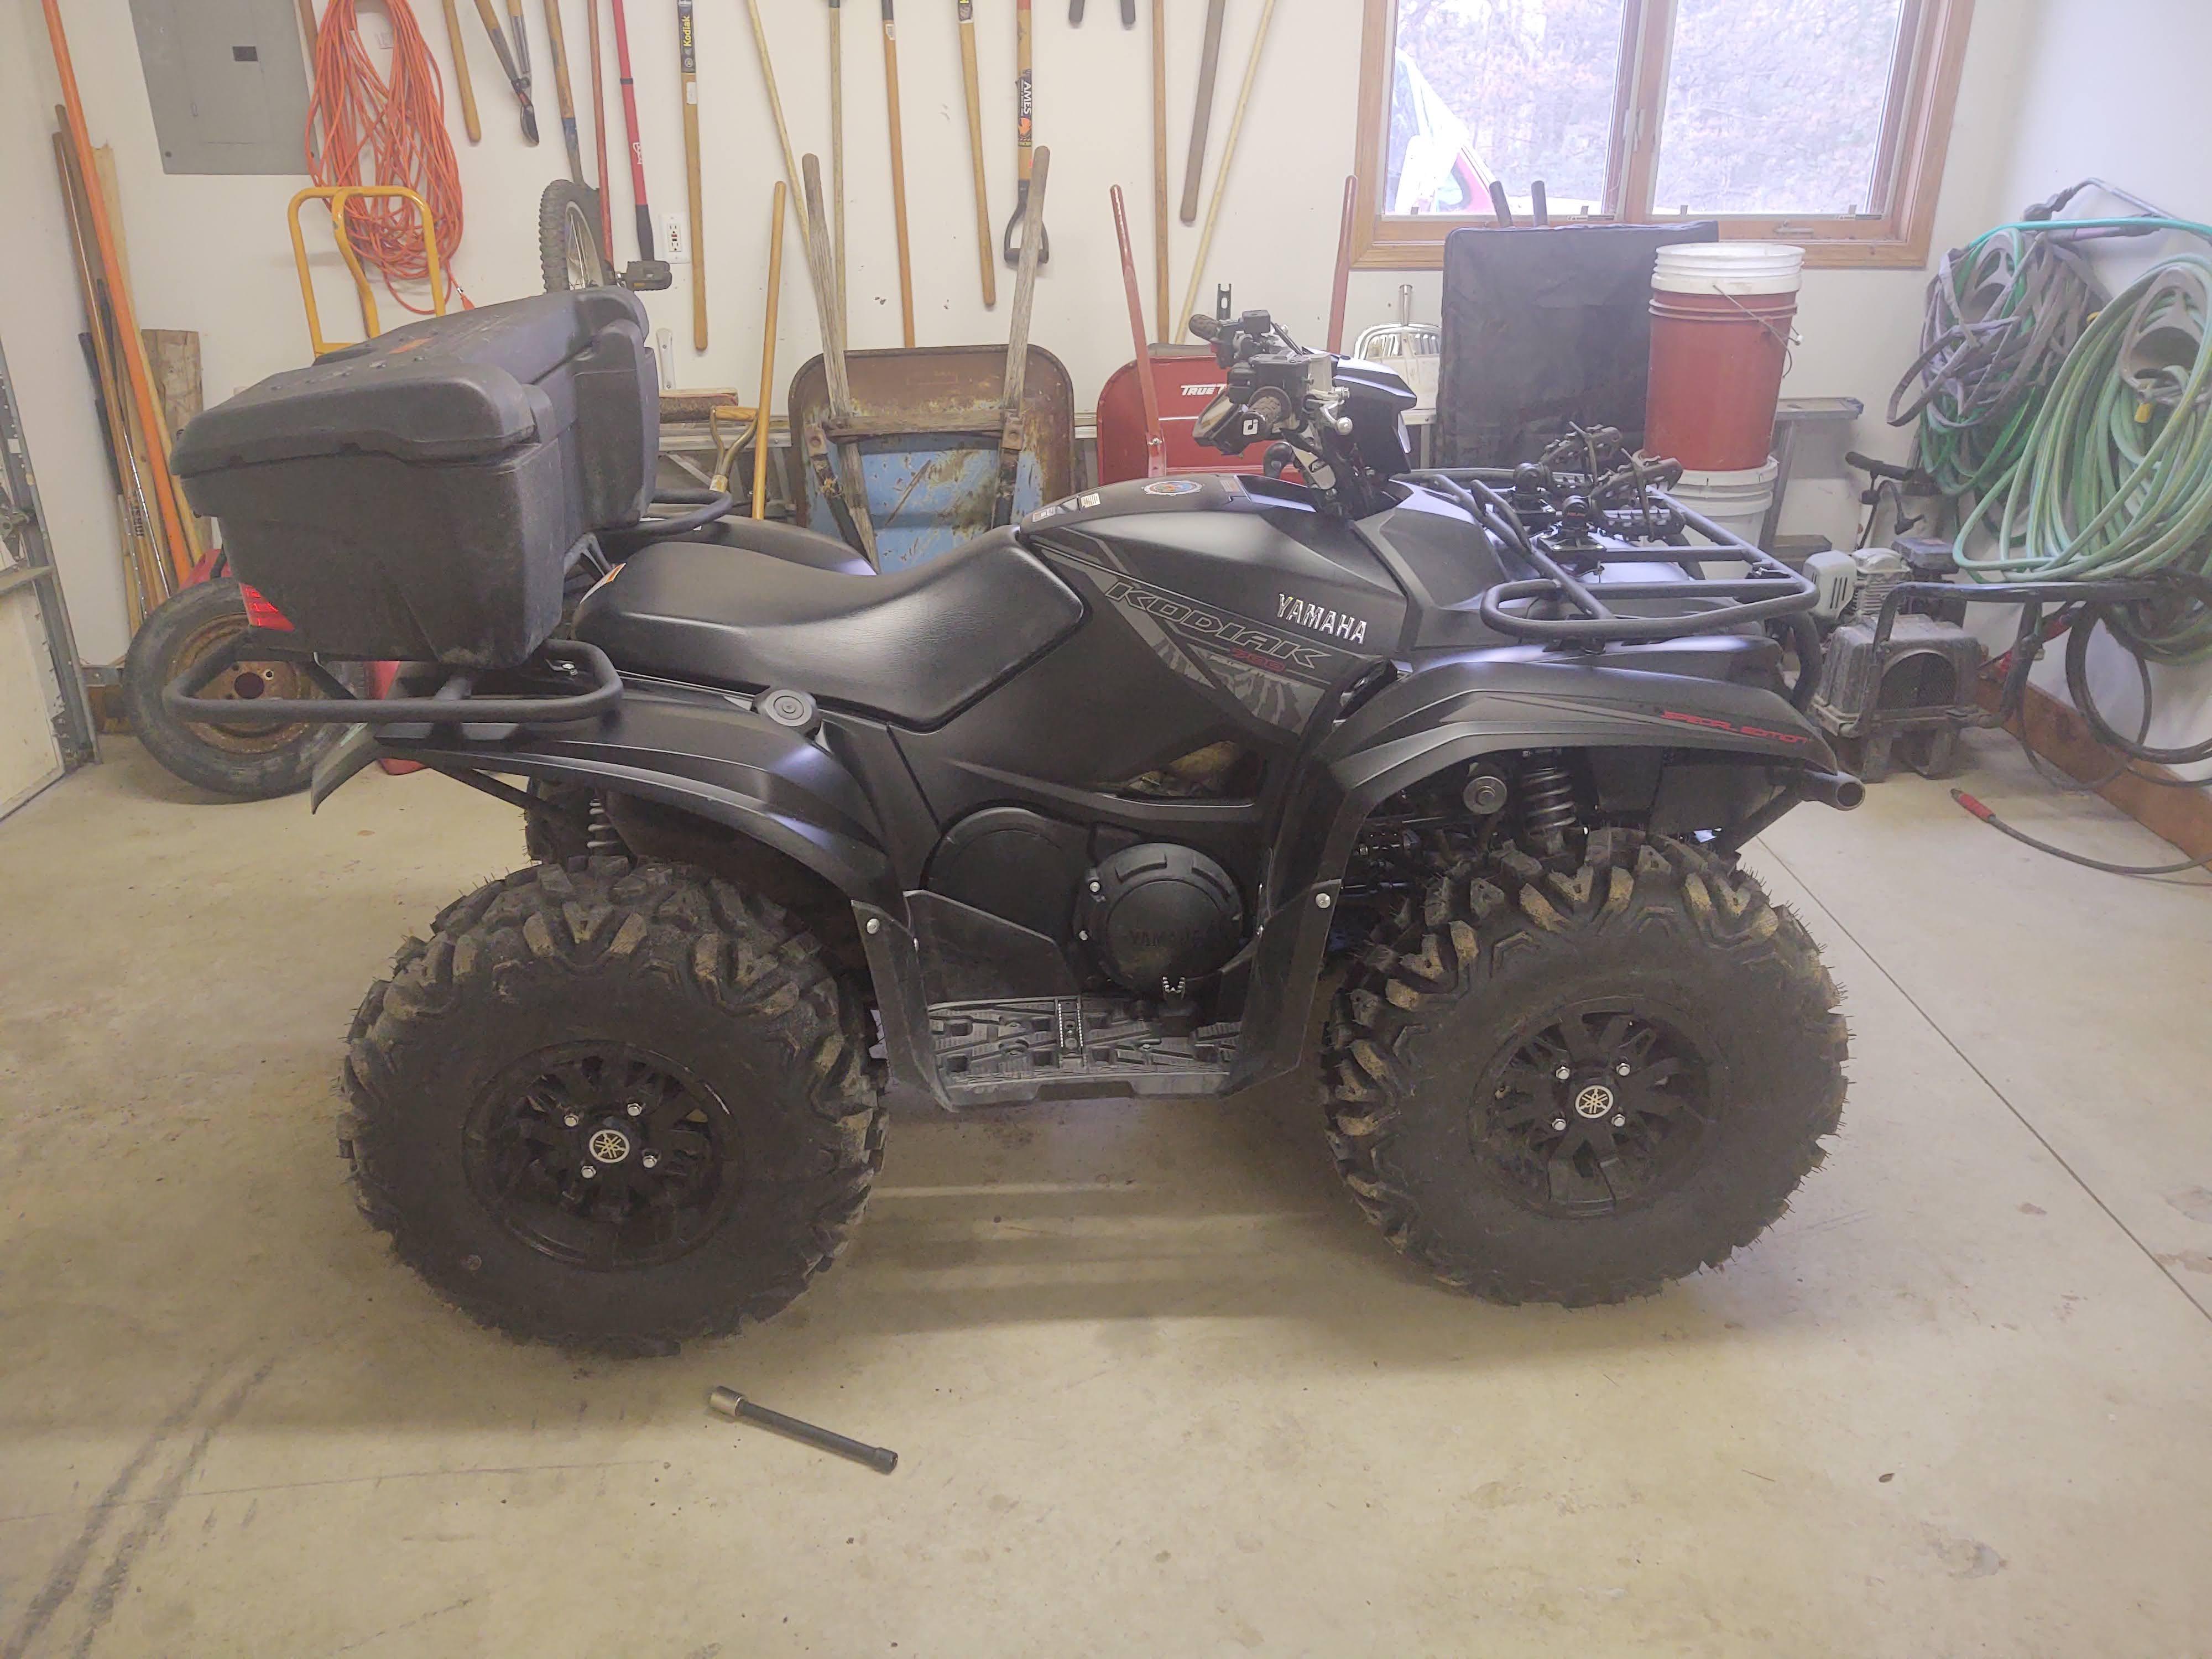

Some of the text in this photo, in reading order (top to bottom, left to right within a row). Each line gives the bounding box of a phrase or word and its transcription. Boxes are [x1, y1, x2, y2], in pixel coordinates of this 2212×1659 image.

[682, 15, 691, 46] Kodiak
[1024, 82, 1032, 114] AMES
[1181, 384, 1216, 395] TRUE
[1105, 582, 1331, 669] KODIAK
[1277, 593, 1368, 644] YAMAHA
